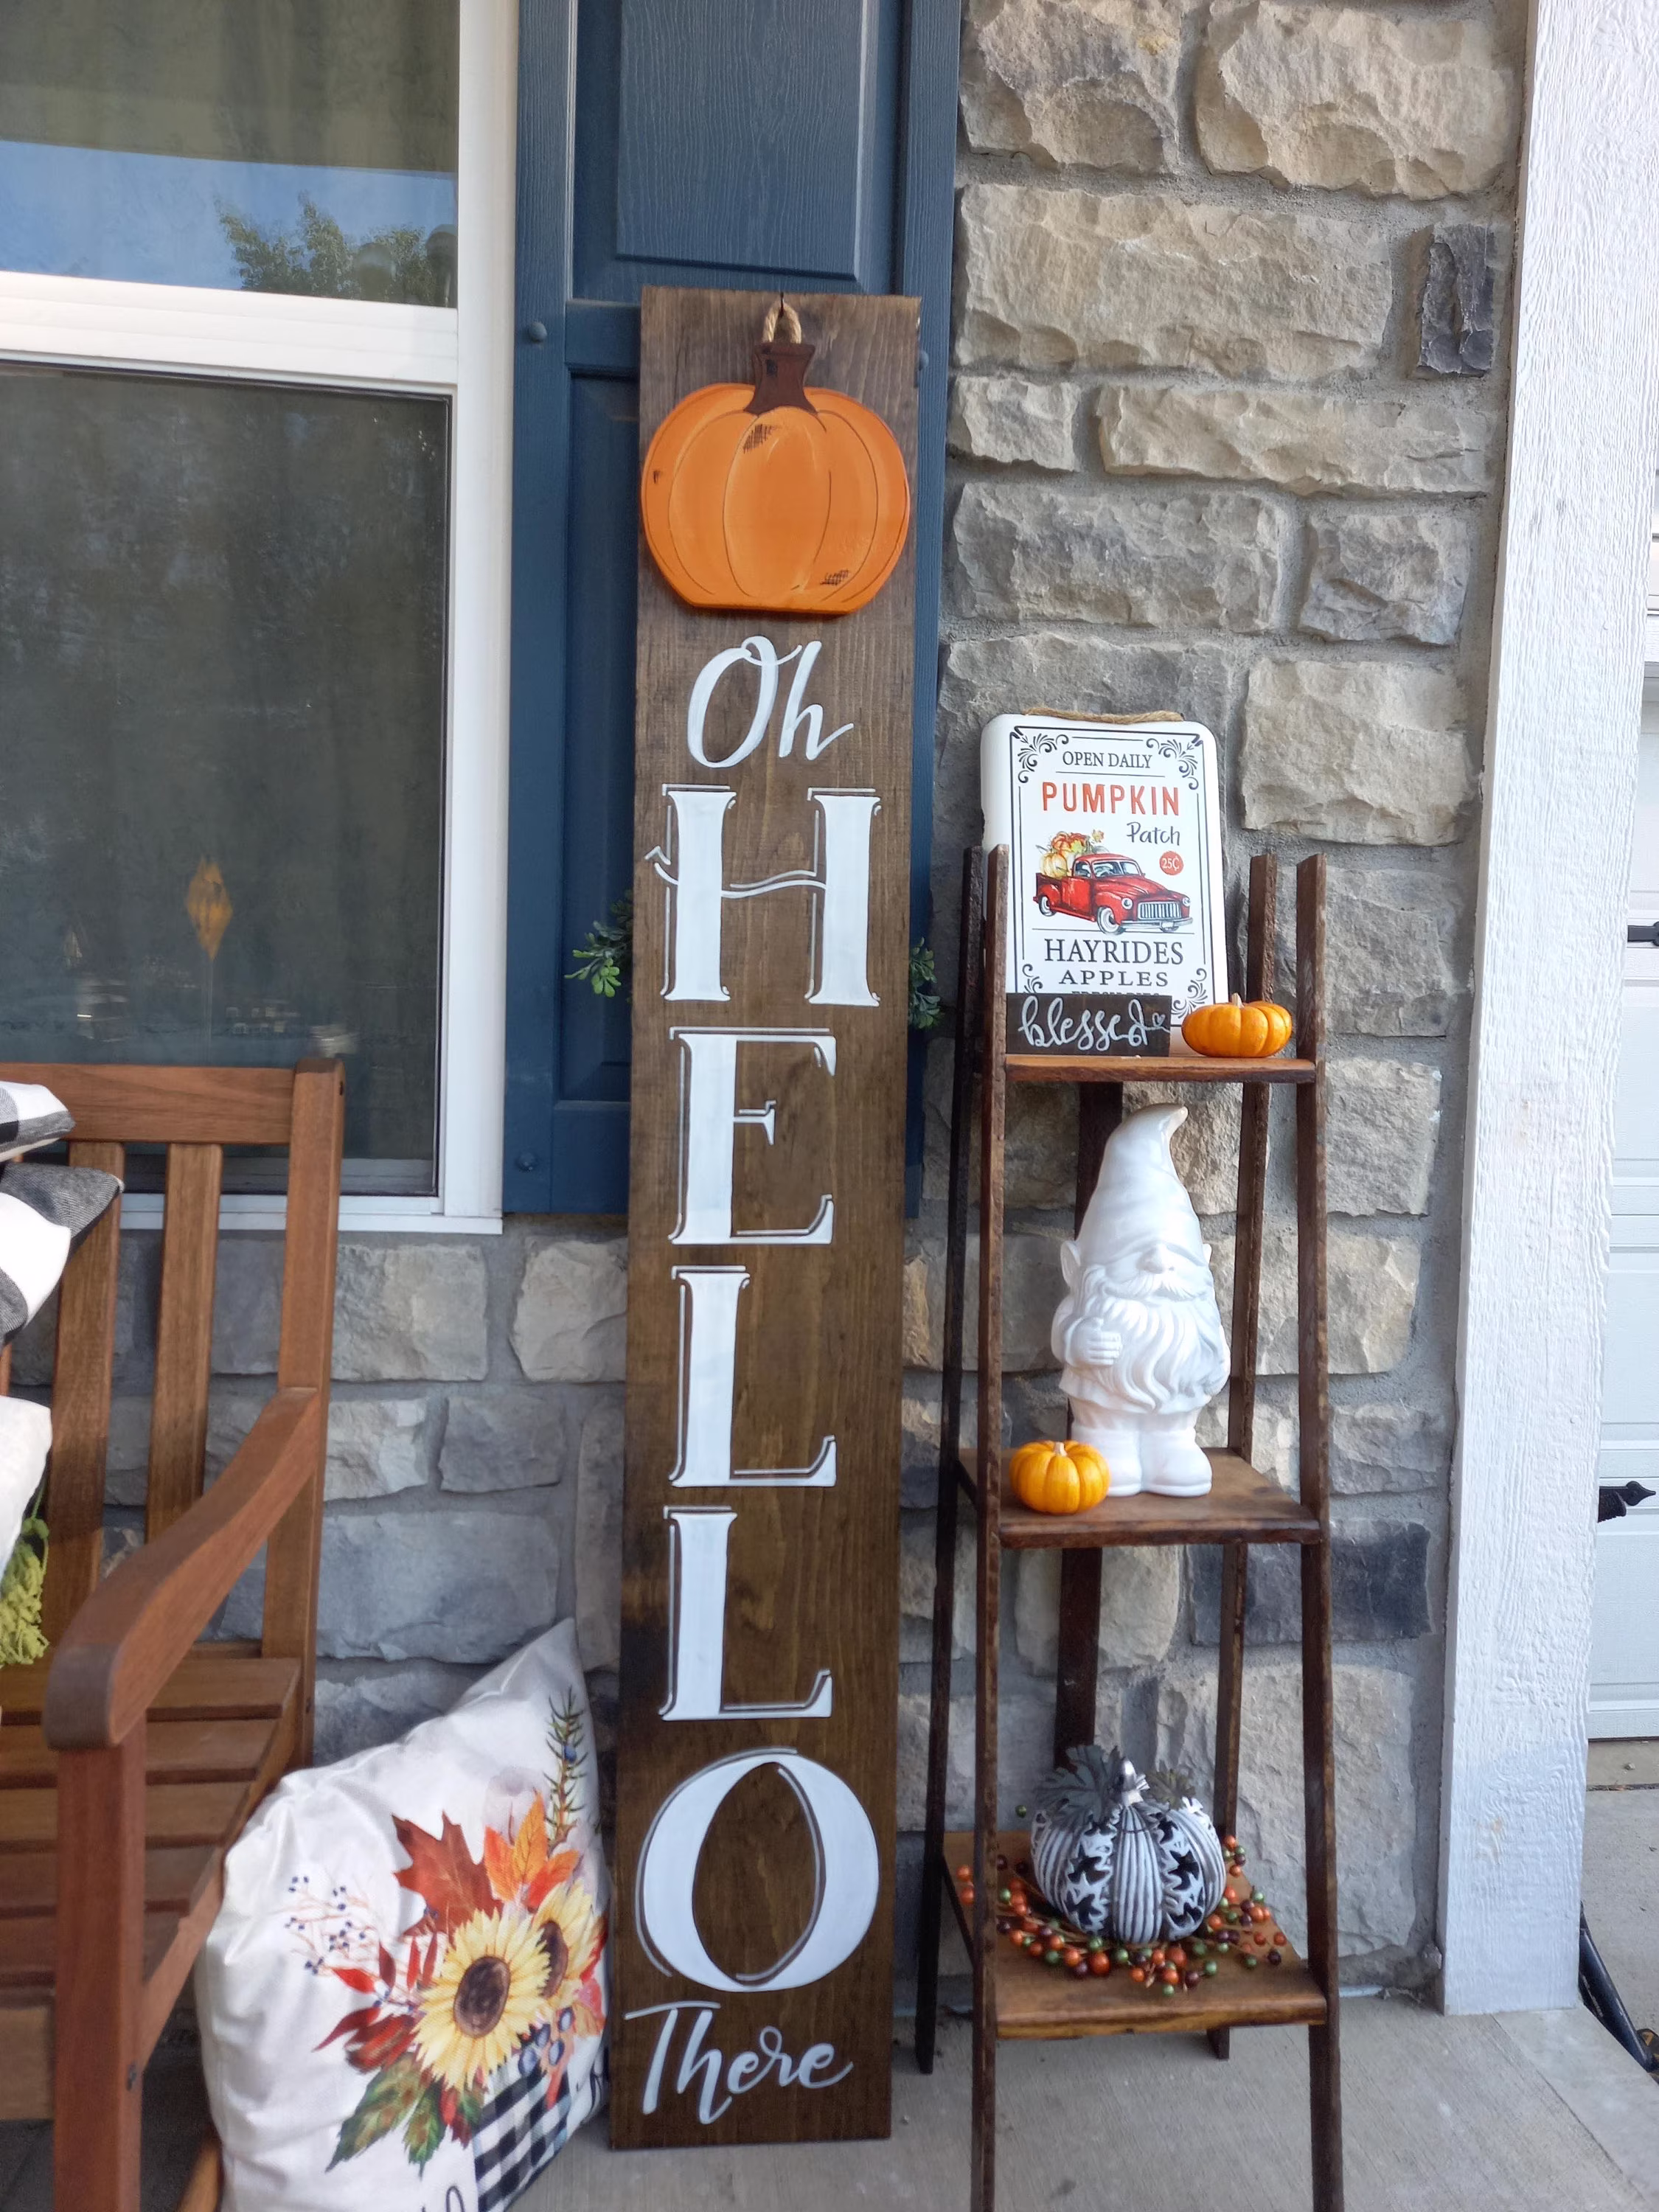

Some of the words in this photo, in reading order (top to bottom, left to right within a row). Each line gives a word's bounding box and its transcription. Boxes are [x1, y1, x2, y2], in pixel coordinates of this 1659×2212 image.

[687, 635, 854, 768] Oh
[1062, 751, 1105, 767] OPEN
[1108, 753, 1152, 768] DAILY
[1042, 782, 1179, 815] PUMPKIN
[1127, 821, 1180, 846] Patch
[1044, 938, 1183, 965] HAYRIDES
[1059, 970, 1169, 987] APPLES
[1018, 995, 1169, 1051] blessed
[635, 784, 881, 1992] HELLO
[624, 2000, 854, 2125] There
